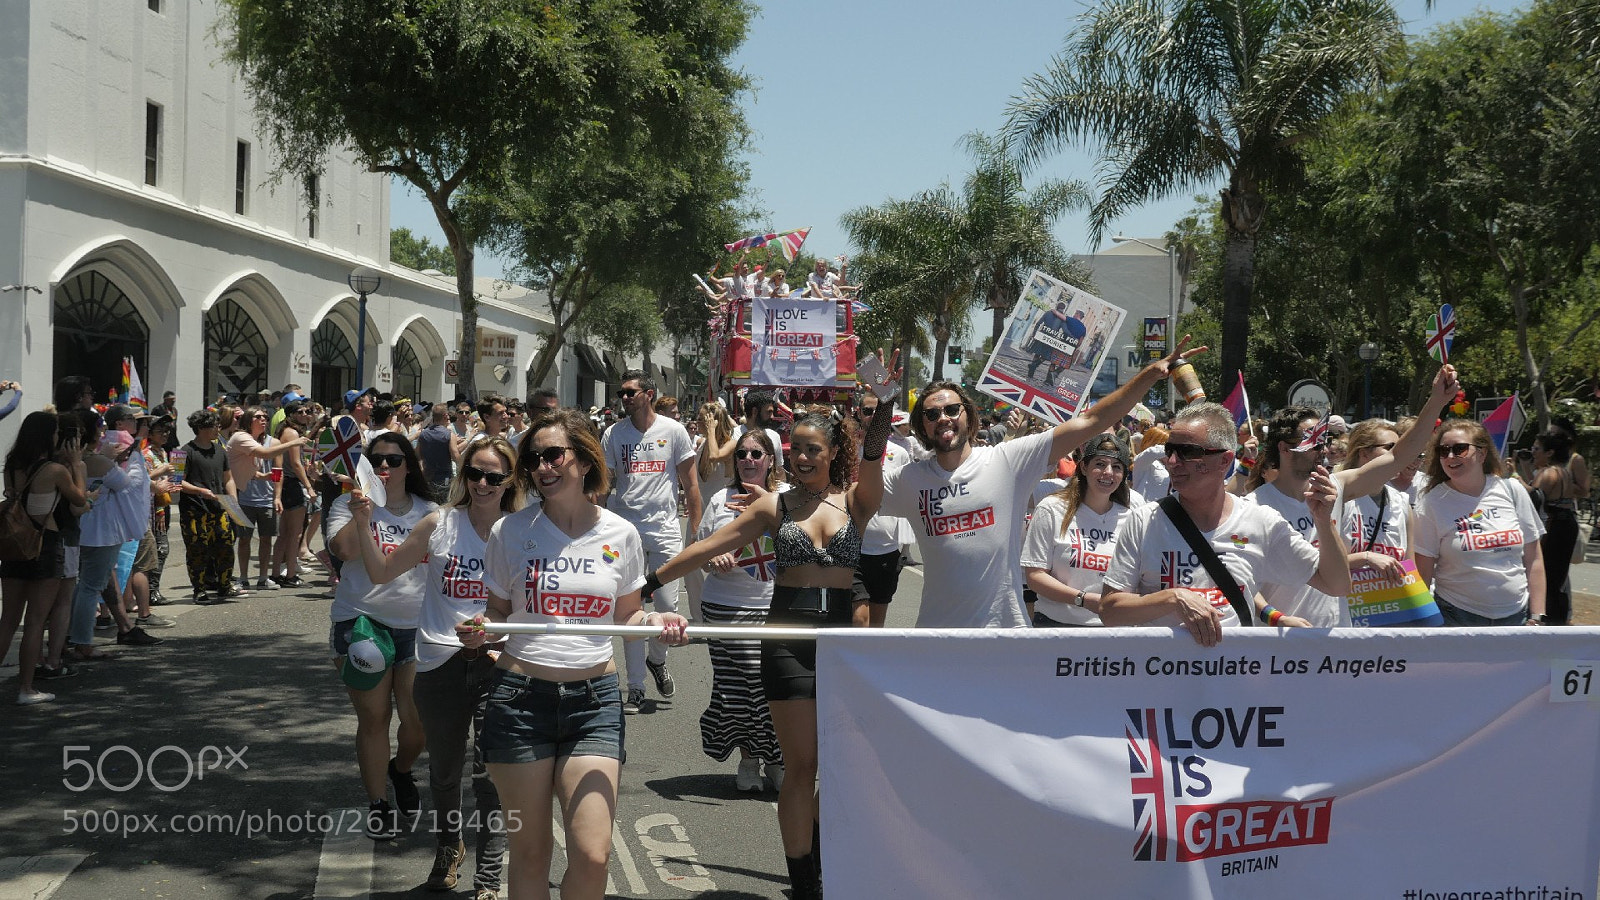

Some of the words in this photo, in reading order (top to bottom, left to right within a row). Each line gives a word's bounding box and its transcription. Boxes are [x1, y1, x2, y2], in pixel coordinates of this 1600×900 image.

[776, 309, 808, 320] LOVE
[776, 321, 787, 331] IS
[497, 336, 516, 349] Tile
[777, 333, 822, 346] GREAT
[1042, 334, 1067, 351] STORIES
[1043, 325, 1065, 340] TRAVEL
[1065, 336, 1079, 346] FOR
[497, 350, 515, 358] STONE
[1062, 376, 1079, 388] LOVE
[1057, 387, 1079, 401] GREAT
[629, 442, 655, 453] LOVE
[629, 453, 639, 461] IS
[631, 461, 665, 472] GREAT
[929, 482, 970, 502] LOVE
[929, 502, 944, 516] IS
[936, 509, 991, 533] GREAT
[1363, 516, 1392, 533] LOE
[1469, 523, 1483, 534] IS
[380, 532, 395, 543] IS
[1081, 528, 1117, 544] LOVE
[1475, 531, 1521, 547] GREAT
[1083, 540, 1096, 552] IS
[542, 556, 596, 574] LOVE
[455, 570, 472, 581] IS
[541, 574, 560, 591] IS
[1177, 569, 1193, 585] IS
[542, 596, 613, 616] GREAT
[1347, 596, 1364, 606] OS
[1350, 602, 1400, 618] NGELES
[1352, 618, 1370, 628] AS
[1056, 656, 1136, 677] British
[1145, 655, 1261, 676] Consulate
[1270, 655, 1309, 675] Los
[1317, 655, 1407, 678] Angeles
[1563, 669, 1593, 696] 61
[1164, 706, 1285, 749] LOVE
[1170, 755, 1213, 798] IS
[1183, 800, 1329, 854] GREAT
[1221, 854, 1279, 877] BRITAIN
